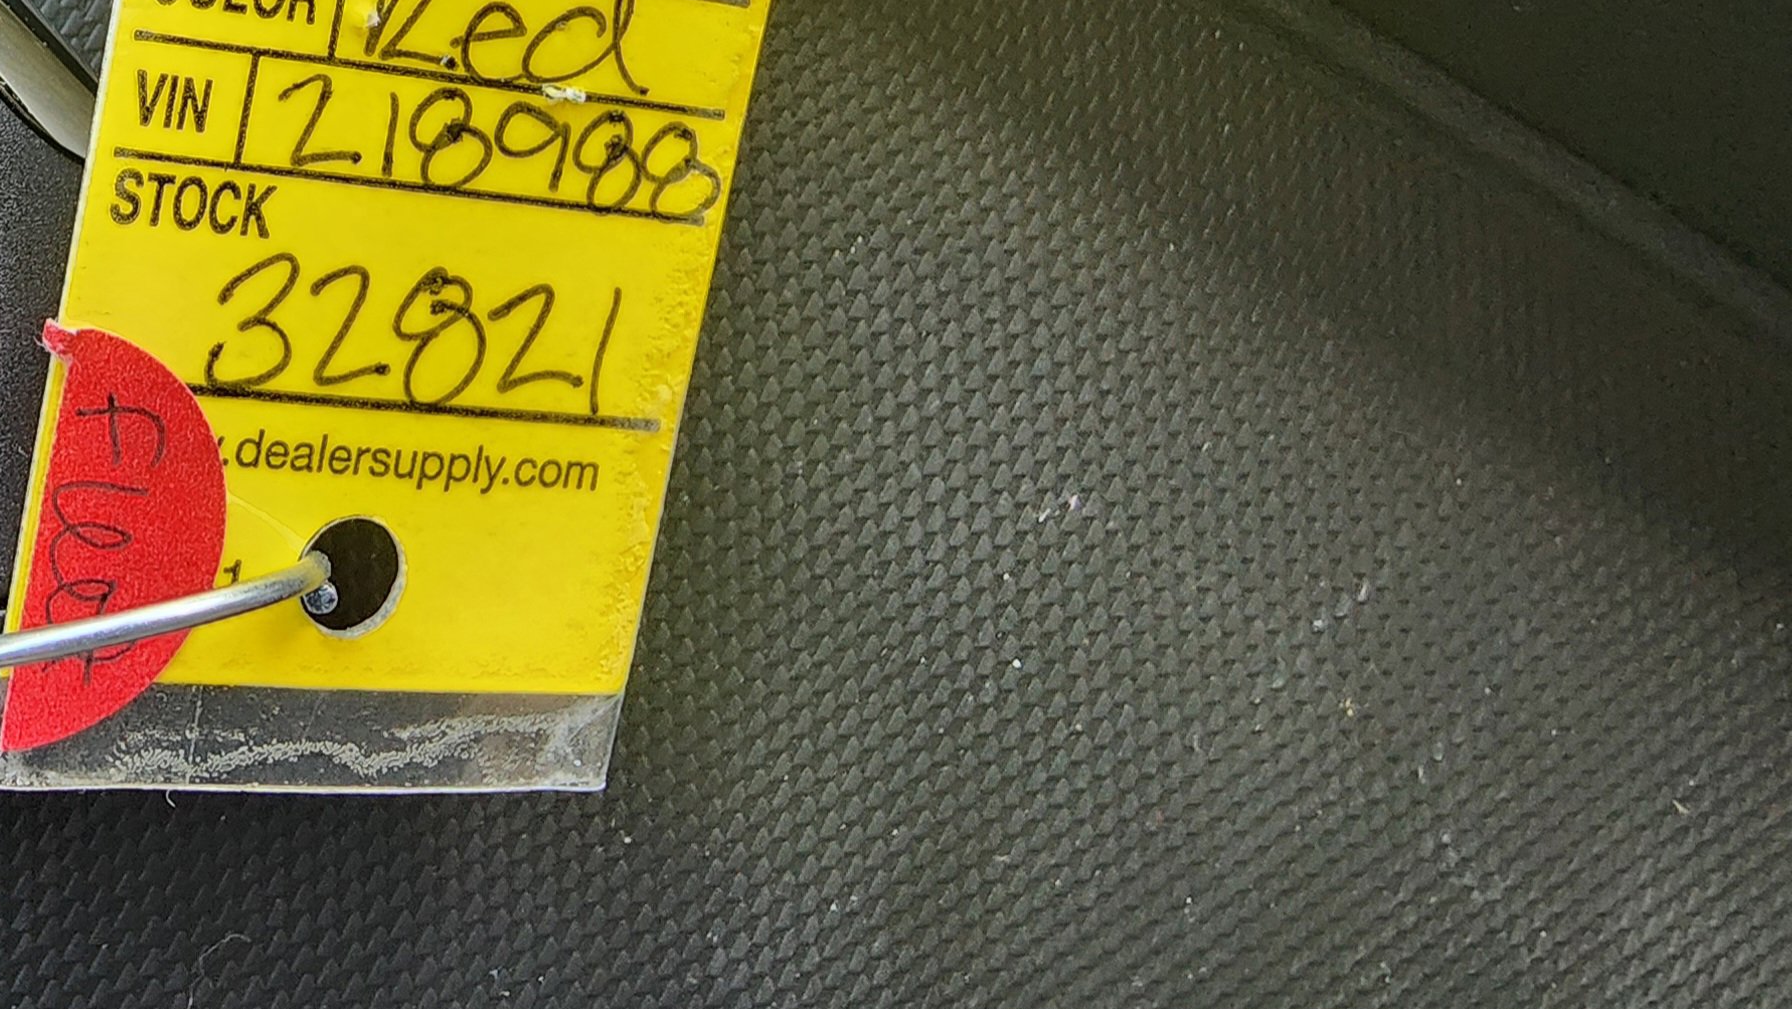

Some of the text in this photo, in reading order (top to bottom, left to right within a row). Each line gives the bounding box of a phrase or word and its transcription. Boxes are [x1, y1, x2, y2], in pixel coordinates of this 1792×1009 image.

[137, 69, 214, 133] VIN
[278, 73, 722, 220] 218988
[109, 168, 279, 240] STOCK
[205, 252, 623, 416] 32821
